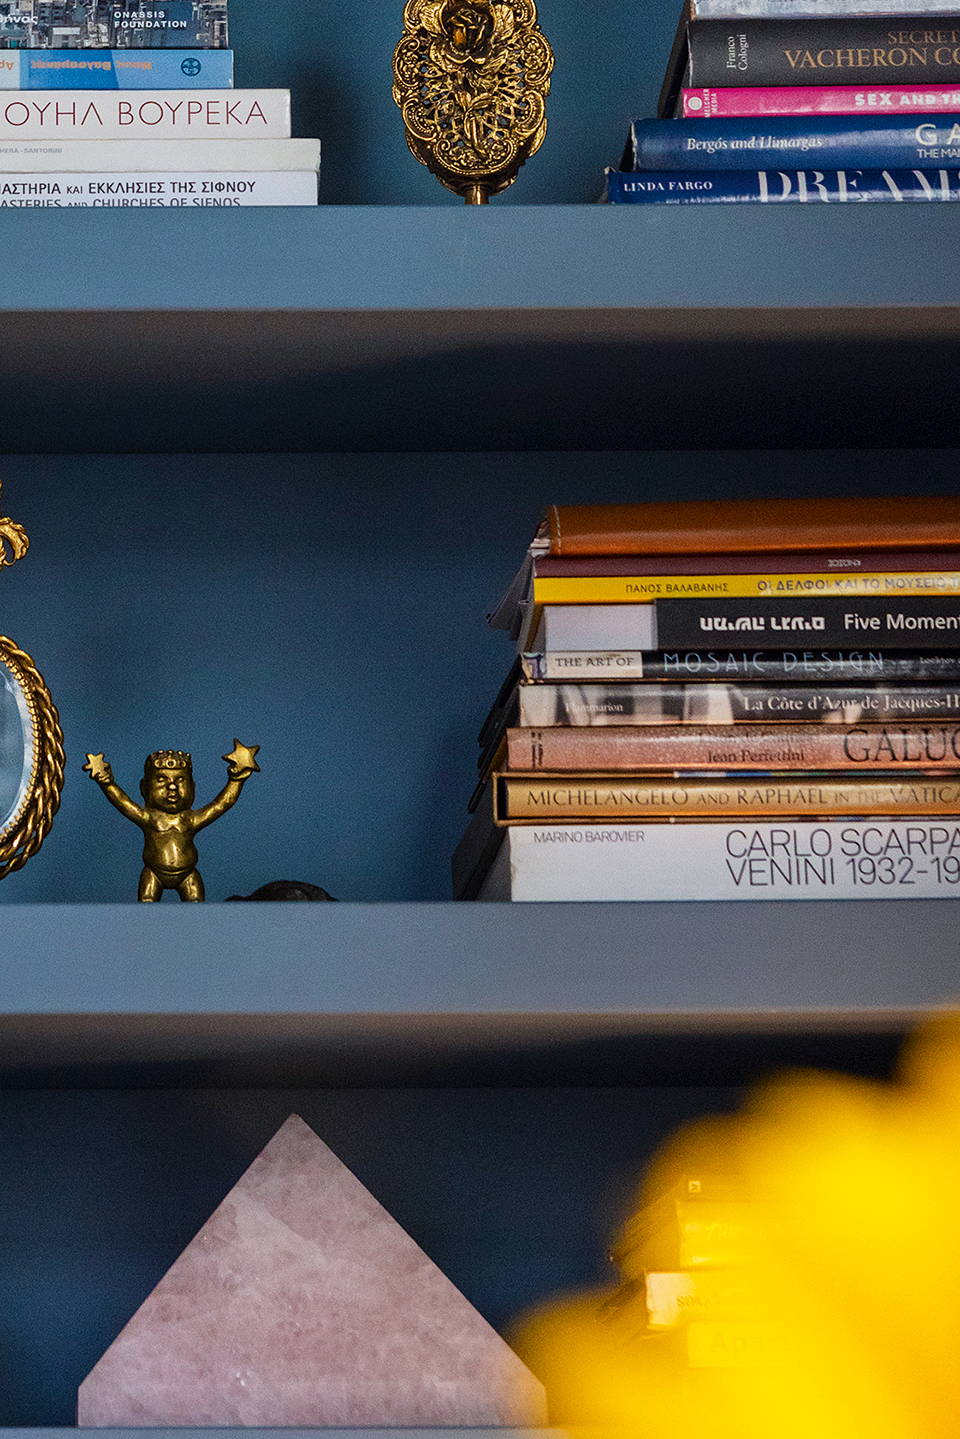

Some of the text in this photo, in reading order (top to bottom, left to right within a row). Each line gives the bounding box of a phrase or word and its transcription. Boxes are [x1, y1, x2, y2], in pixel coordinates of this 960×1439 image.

[114, 11, 165, 19] ONASSIS
[114, 20, 187, 28] FOUNDATION
[727, 36, 736, 69] Franco
[738, 34, 748, 71] Cologni
[783, 46, 929, 68] VACHERON
[855, 93, 936, 106] SEX AND
[118, 100, 268, 125] ΒΟΥΡΕΚΑ
[687, 136, 728, 153] Bergós
[731, 137, 756, 149] and
[917, 149, 939, 159] THE
[66, 186, 83, 195] ΚΑΙ
[89, 182, 165, 194] ΕΚΚΛΗΣΙΕΣ
[170, 182, 197, 194] ΤΗΣ
[201, 180, 256, 193] ΣΙΦΝΟΥ
[623, 180, 713, 192] LINDA FARGO
[626, 581, 729, 594] ΠΑΝΟΣ ΒΑΛΑΒΑΝΗΣ
[776, 579, 830, 591] ΔΕΛΦΟΙ
[834, 578, 858, 589] ΚΑΙ
[862, 578, 881, 589] ΤΟ
[700, 616, 825, 631] חמישה רגעים
[844, 613, 880, 630] Five
[555, 656, 635, 668] THE ART OF
[664, 651, 764, 672] MOSAIC
[783, 650, 884, 672] DESIGN
[744, 696, 763, 711] La
[768, 694, 804, 710] Côte
[861, 696, 879, 709] de
[708, 750, 737, 763] Jean
[527, 789, 689, 807] MICHELANGELO
[696, 792, 730, 804] AND
[737, 788, 828, 805] RAPHAEL
[534, 830, 645, 844] MARINO BAROVIER
[725, 829, 832, 859] CARLO
[725, 857, 835, 887] VENINI
